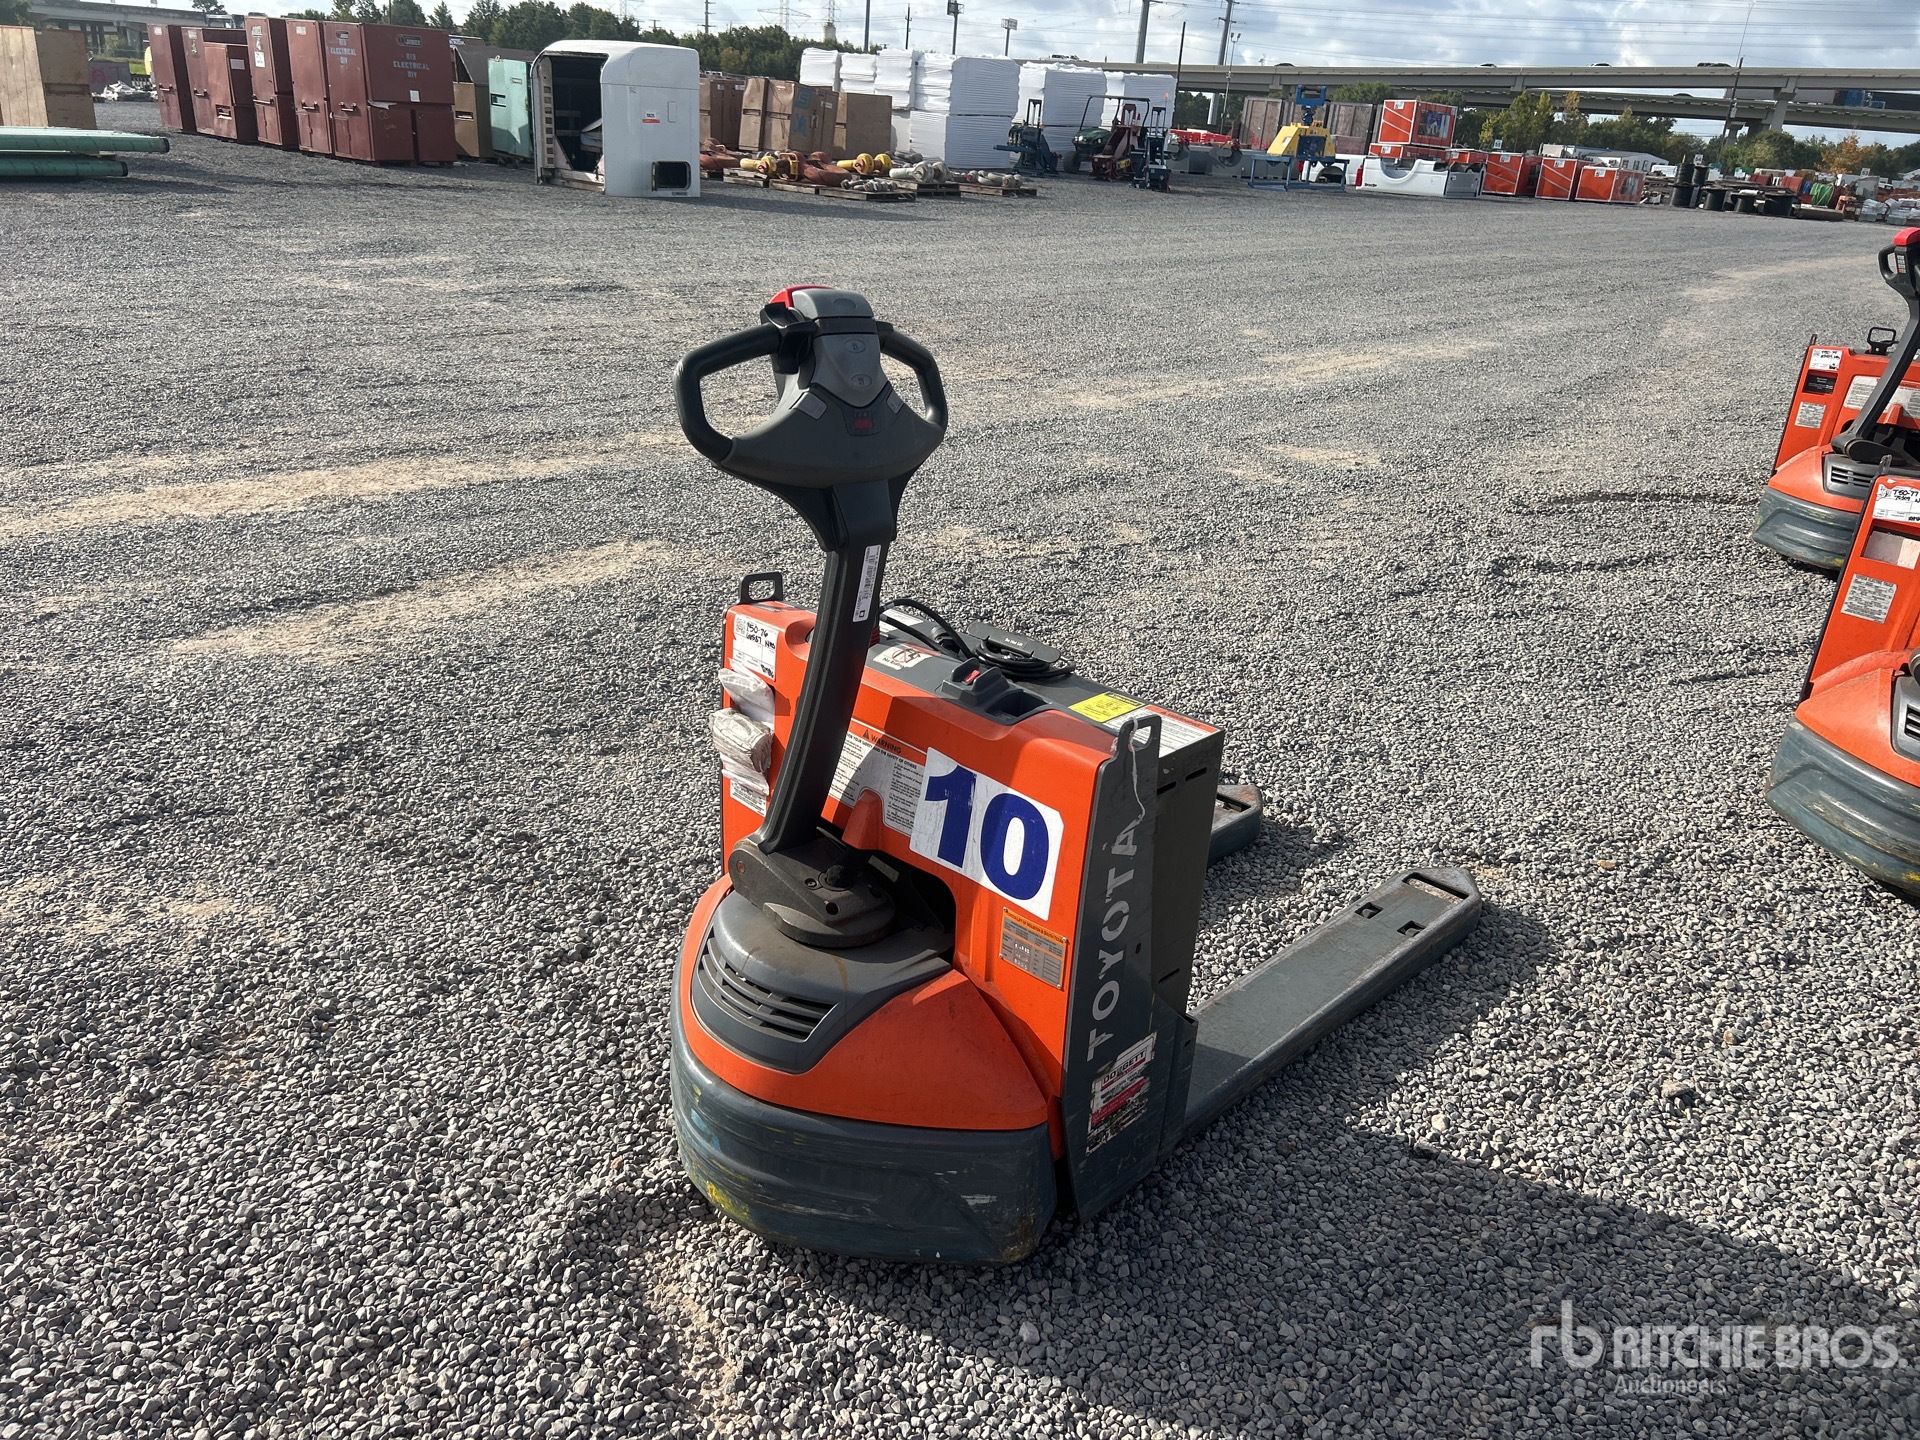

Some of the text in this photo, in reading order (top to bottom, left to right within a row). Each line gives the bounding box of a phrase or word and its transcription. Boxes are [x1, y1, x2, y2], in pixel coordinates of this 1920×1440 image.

[393, 61, 430, 70] ELECTRICAL
[862, 739, 873, 748] SAFETY
[886, 752, 899, 762] SAFETY
[903, 759, 917, 770] OTHERS
[871, 734, 902, 754] WARNING
[925, 765, 1050, 901] 10
[1086, 815, 1143, 1062] TOYOTA
[1102, 1049, 1146, 1084] DOGETT
